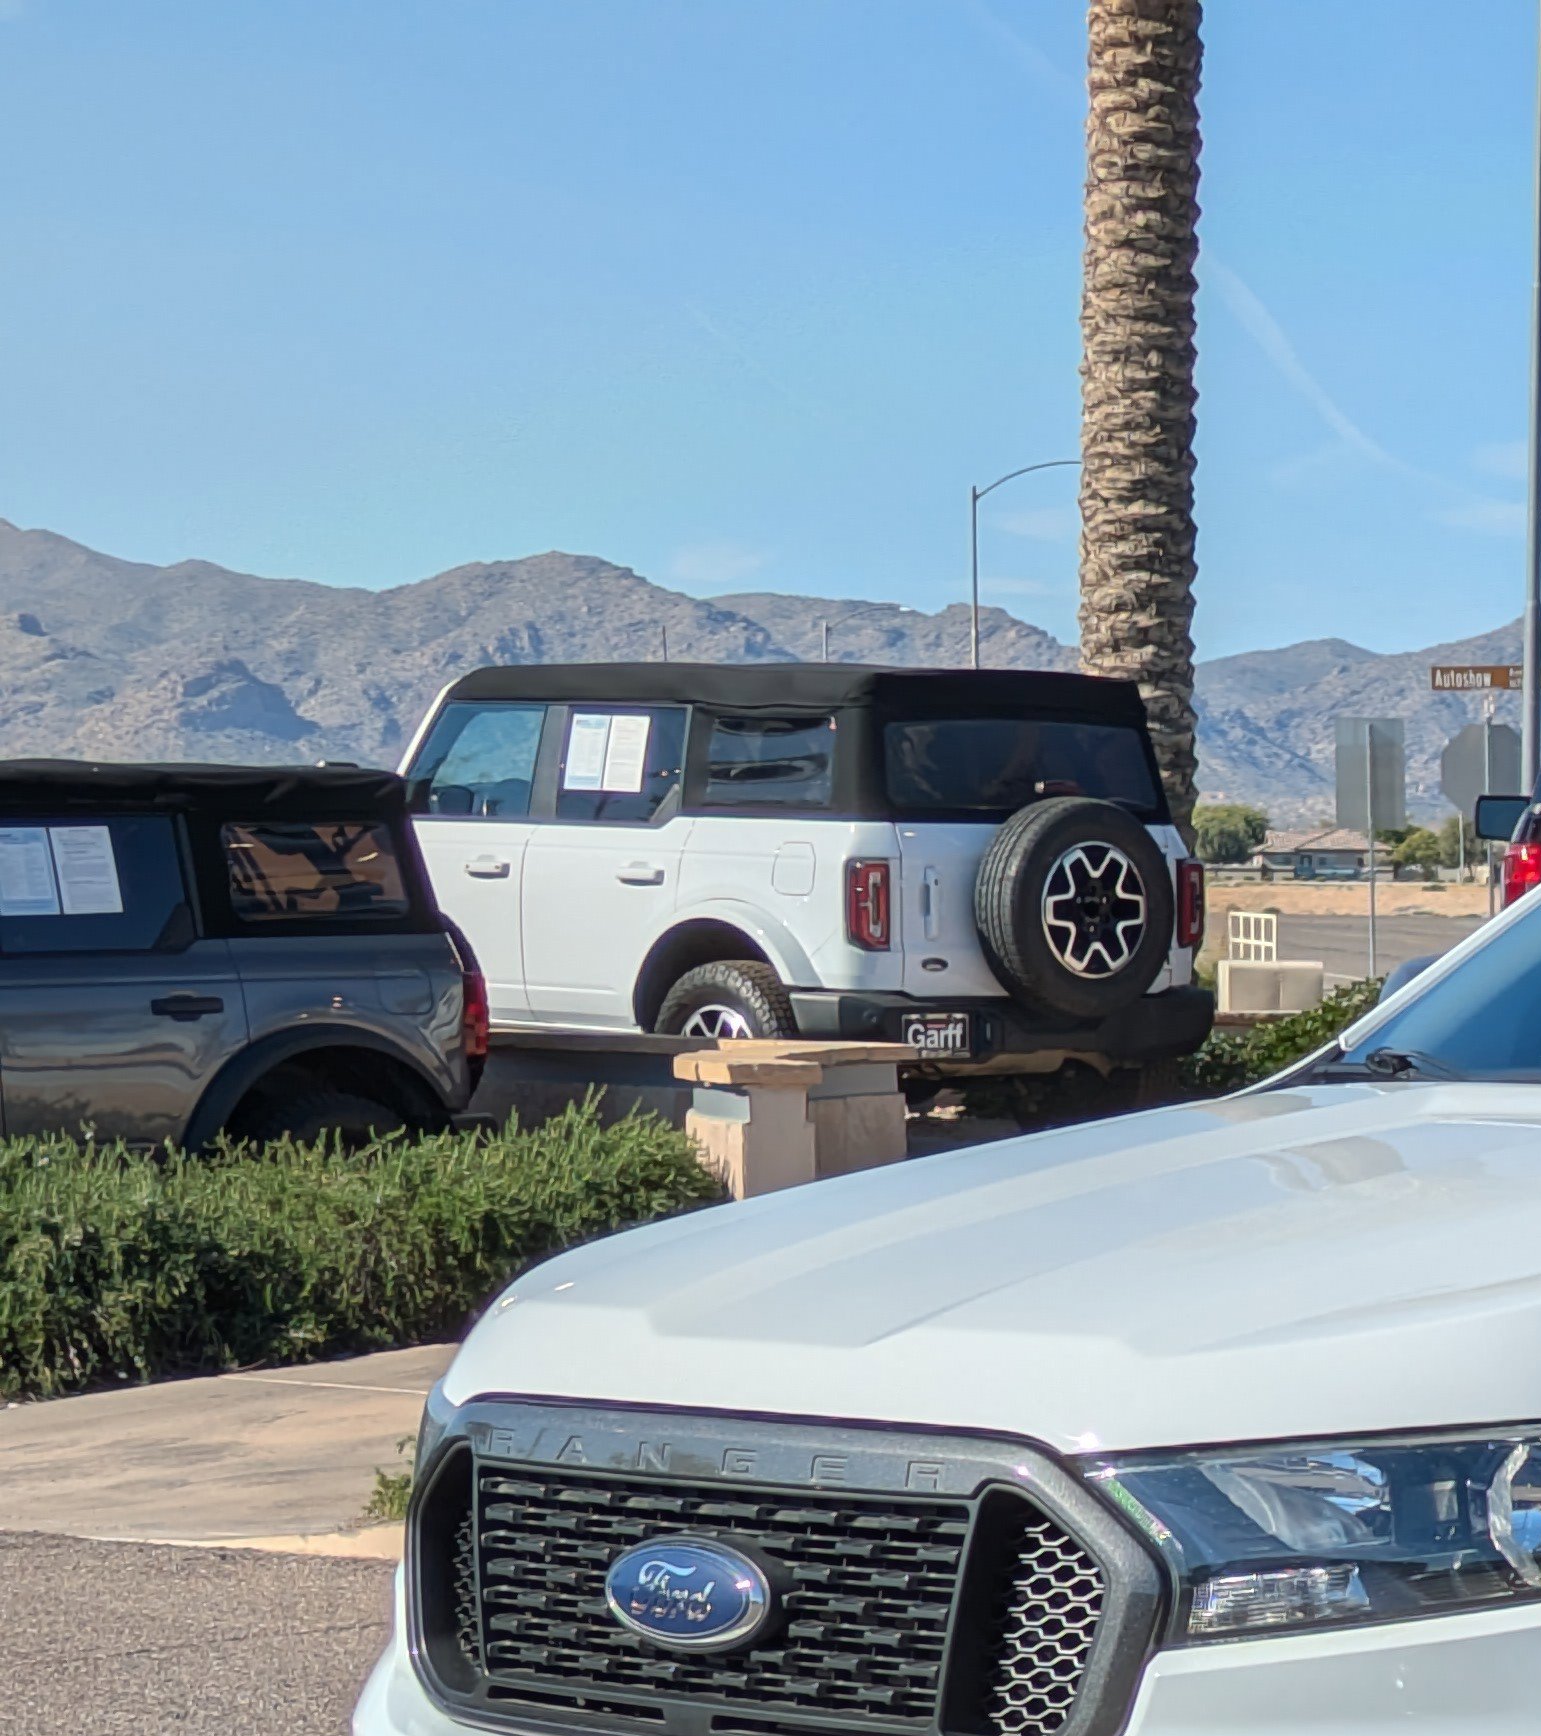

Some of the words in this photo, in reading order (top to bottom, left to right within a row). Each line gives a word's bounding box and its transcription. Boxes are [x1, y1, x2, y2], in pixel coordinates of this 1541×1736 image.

[1435, 669, 1492, 688] Autoshow
[907, 1022, 964, 1048] Garff
[487, 1427, 946, 1491] RANGER
[630, 1560, 715, 1622] Ford
